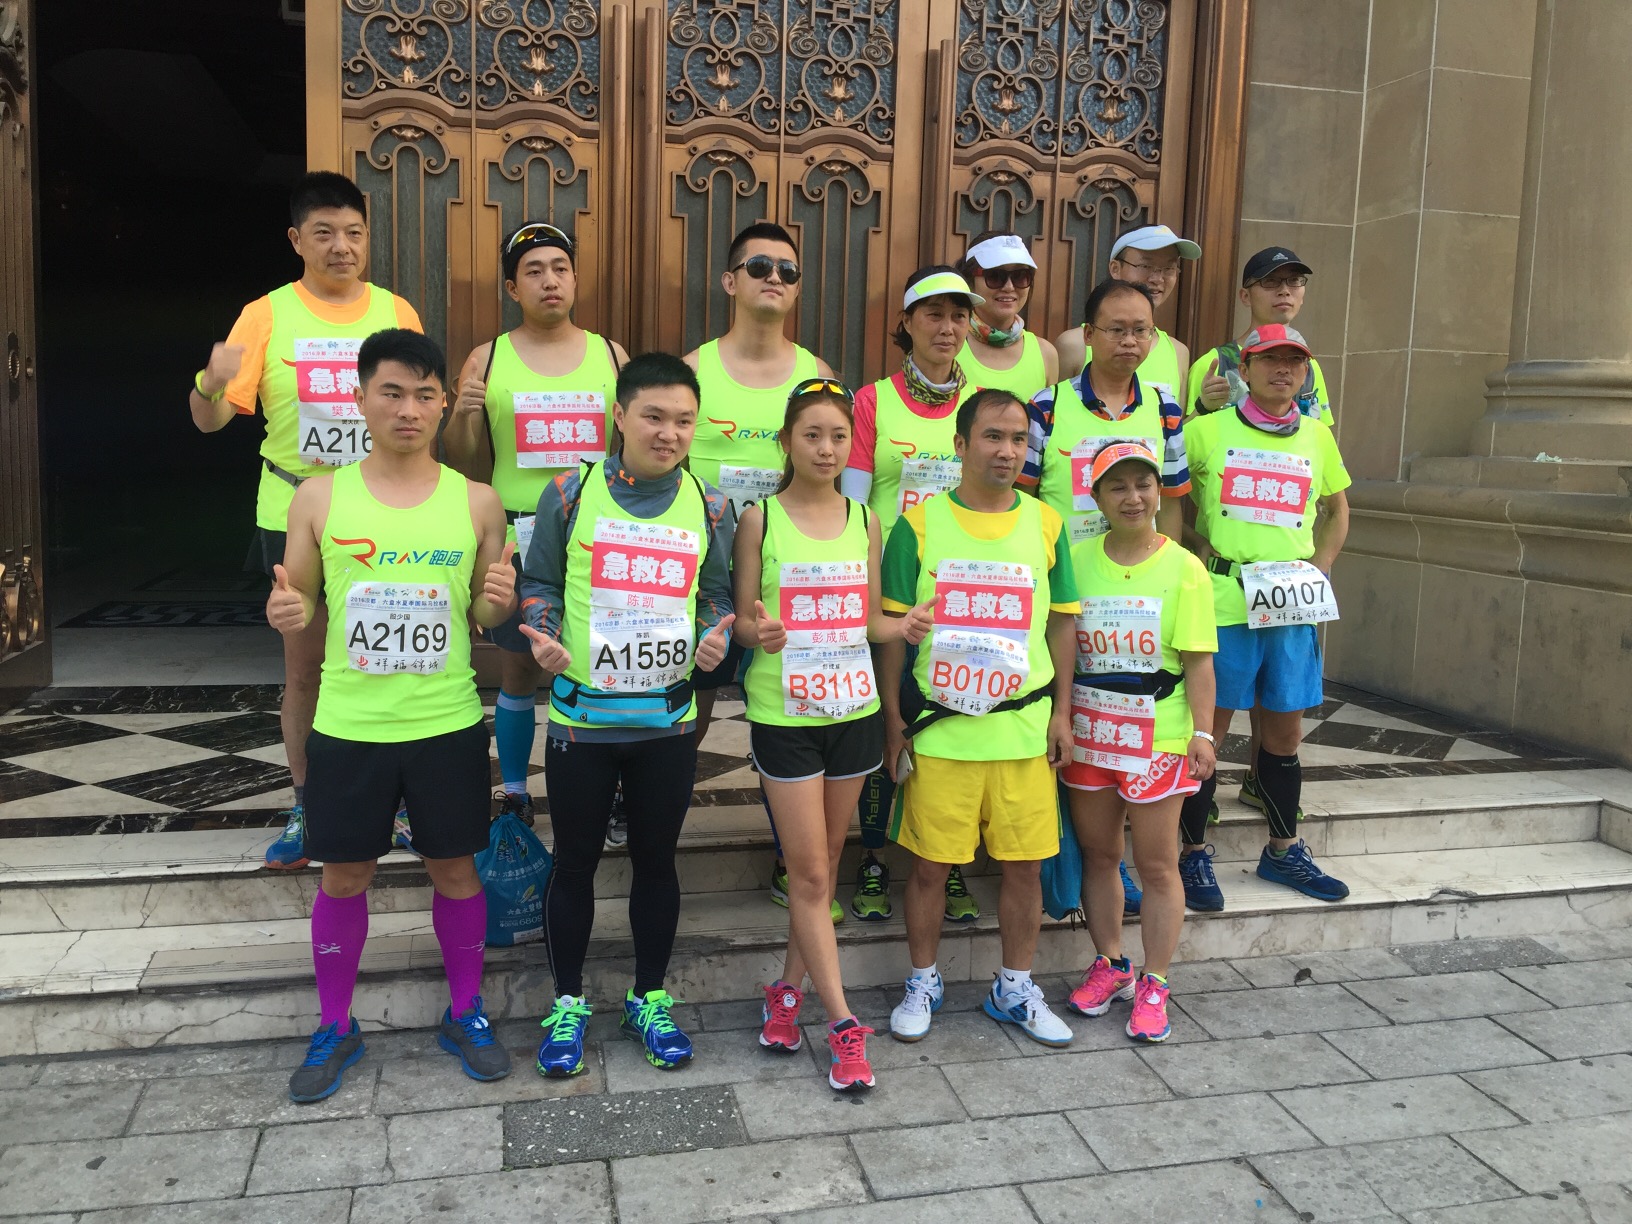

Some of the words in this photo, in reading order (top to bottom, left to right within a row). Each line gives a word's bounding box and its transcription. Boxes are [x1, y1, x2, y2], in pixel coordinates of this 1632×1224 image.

[379, 551, 430, 565] RAY
[429, 550, 463, 566] 跑团
[627, 594, 655, 609] 陈凯
[1250, 580, 1325, 611] A0107
[348, 620, 447, 653] A2169
[1076, 629, 1156, 656] B0116
[594, 638, 687, 670] A1558
[789, 670, 871, 701] B3113
[932, 661, 1022, 698] B0108
[1083, 750, 1122, 767] 薛凤玉
[1127, 752, 1180, 799] adidas
